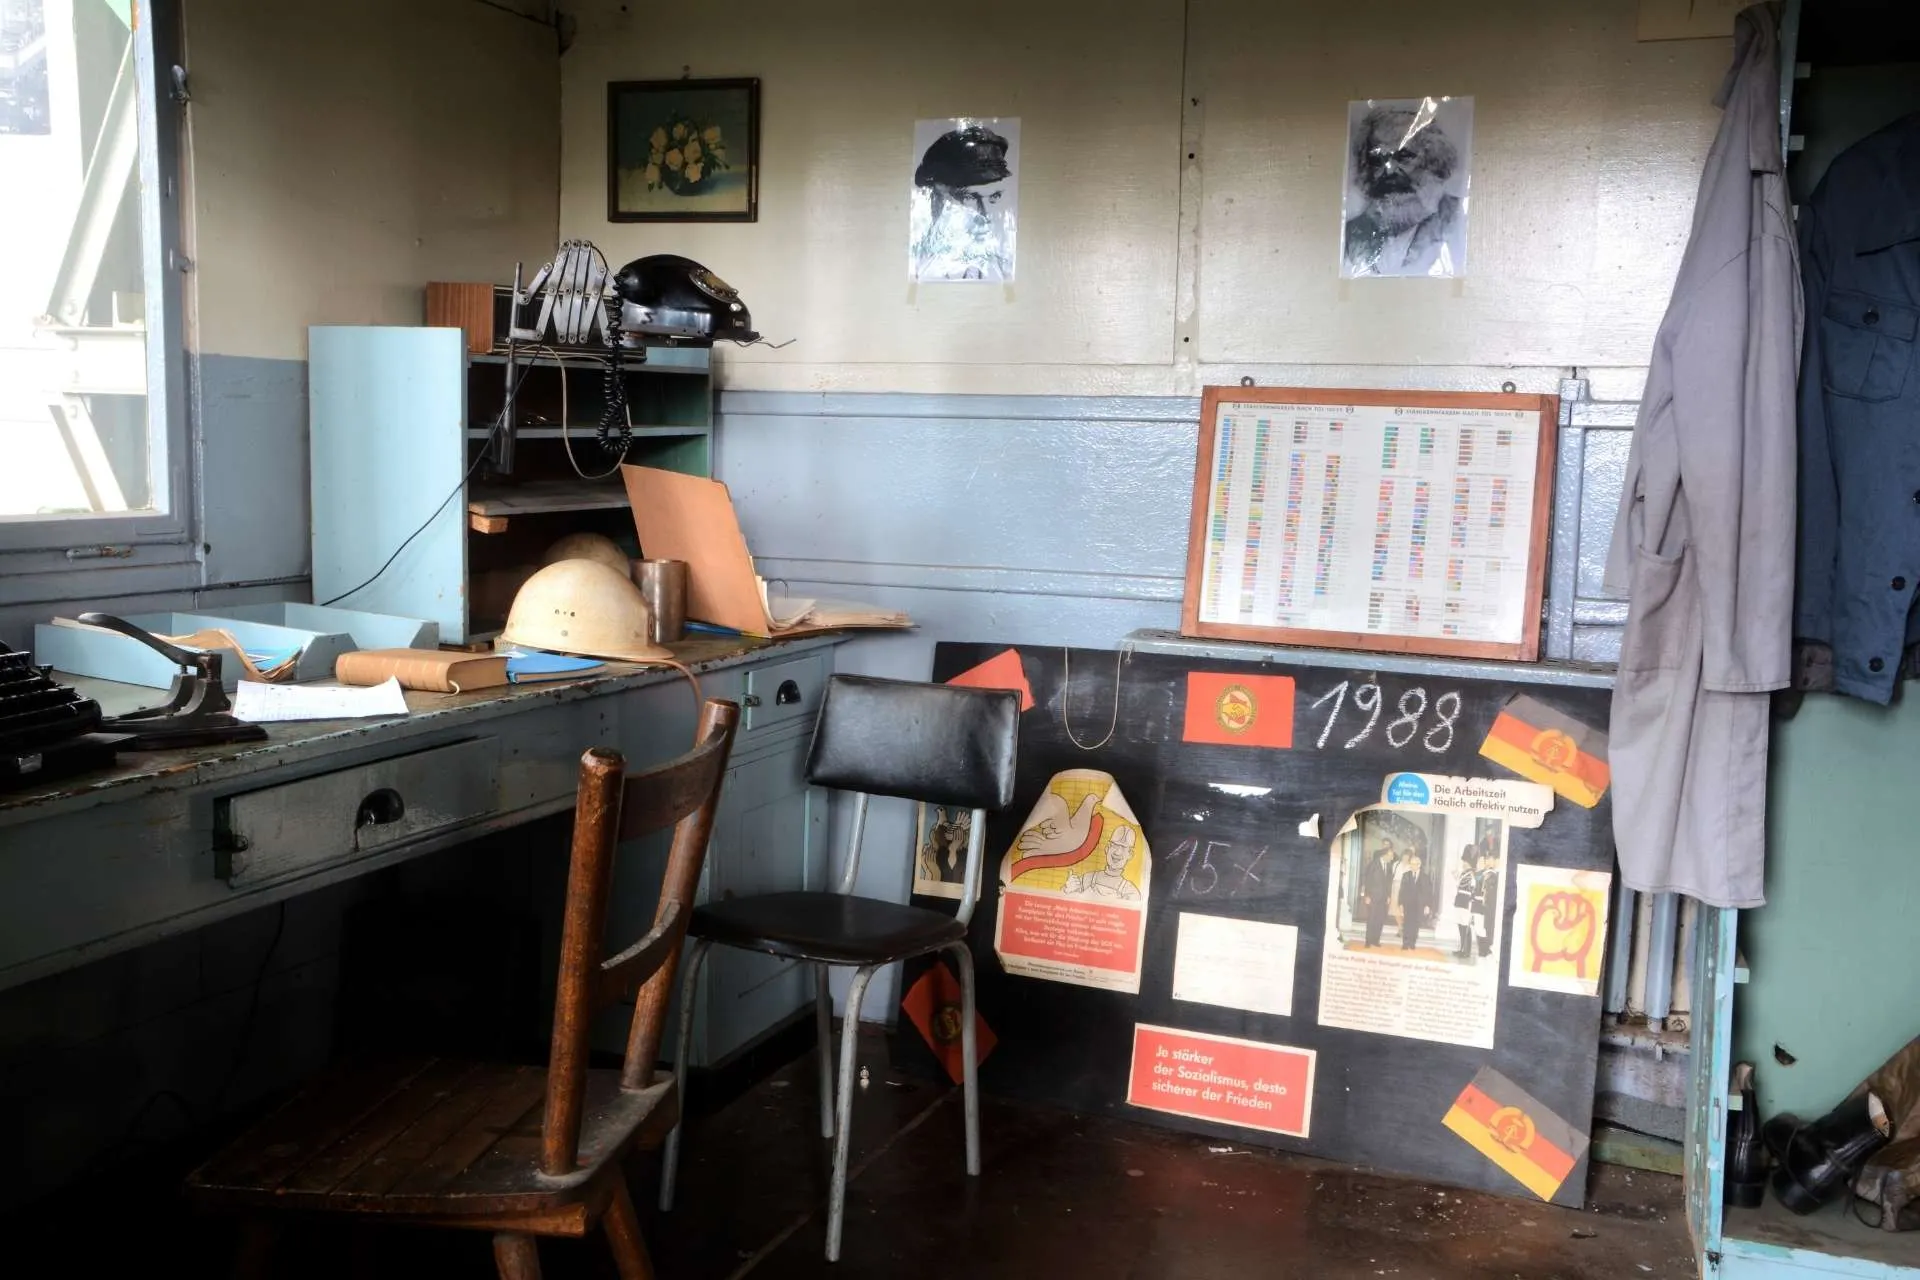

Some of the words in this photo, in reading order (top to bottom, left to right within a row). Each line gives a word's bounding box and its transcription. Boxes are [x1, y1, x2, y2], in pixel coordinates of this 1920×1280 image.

[1311, 679, 1463, 754] 1988
[1434, 784, 1451, 794] Die
[1453, 785, 1507, 799] Arbeitszeit
[1434, 798, 1466, 809] täglich
[1469, 799, 1505, 812] effektiv
[1508, 804, 1540, 815] nutzen
[1165, 838, 1232, 898] 15
[1155, 1045, 1168, 1058] Je
[1172, 1047, 1215, 1065] stärker
[1153, 1062, 1174, 1078] der
[1177, 1065, 1249, 1091] Sozialismus,
[1253, 1078, 1287, 1095] desto
[1152, 1079, 1198, 1097] sicherer
[1201, 1087, 1223, 1102] der
[1226, 1090, 1272, 1111] Frieden
